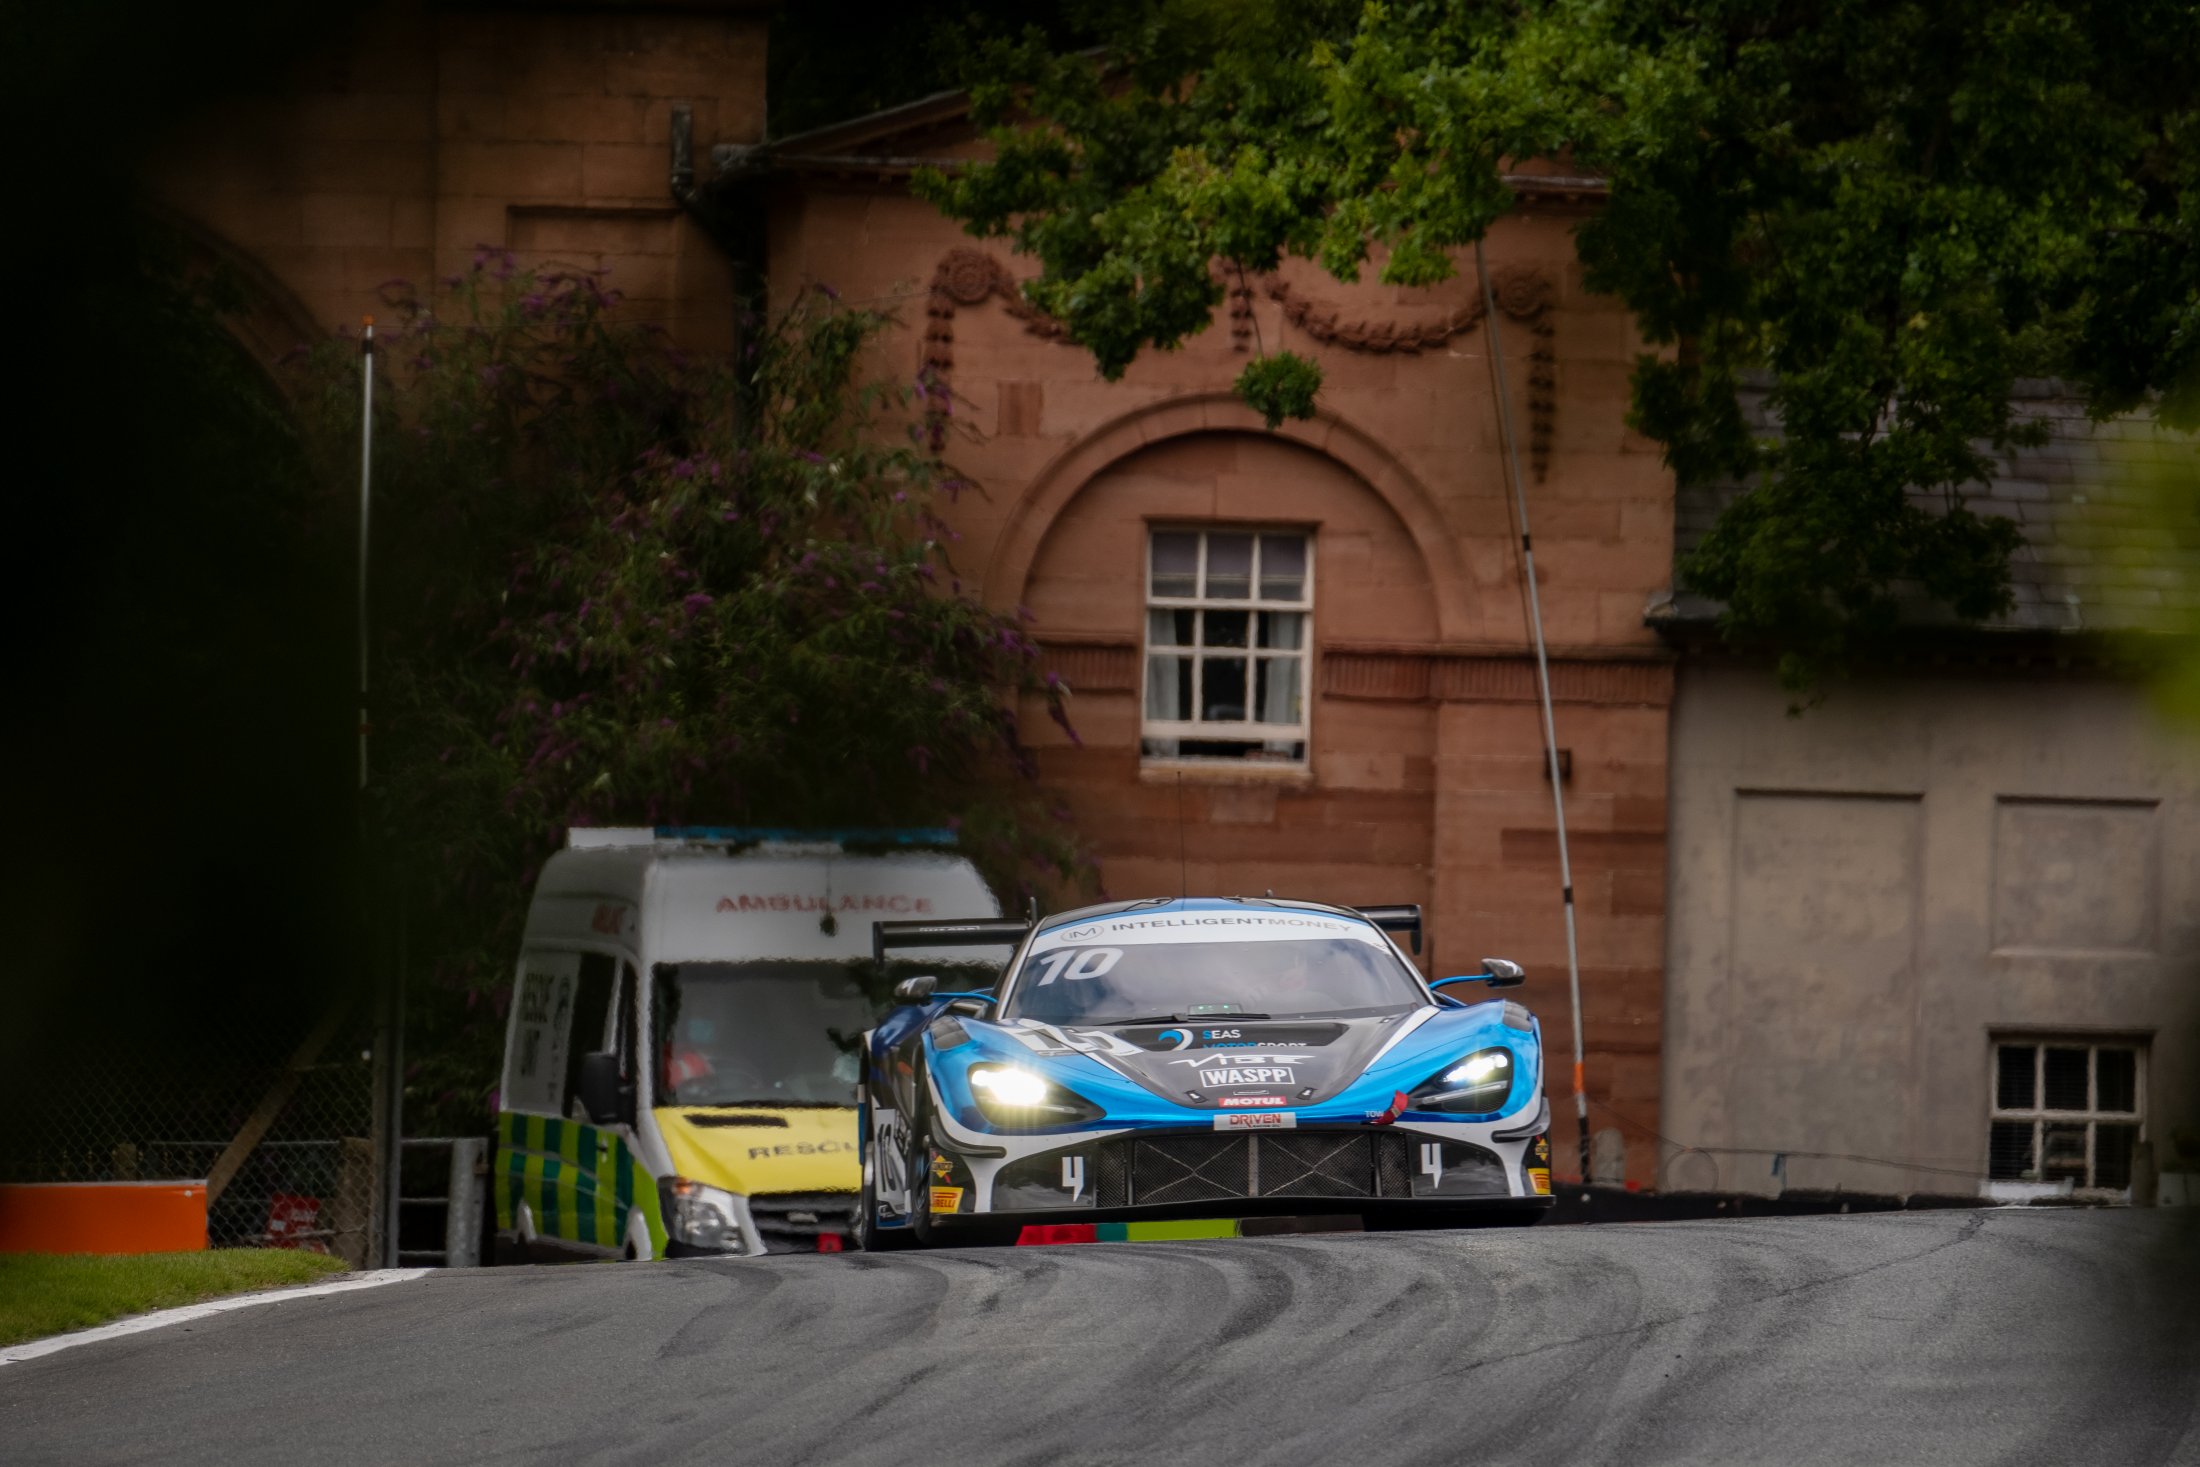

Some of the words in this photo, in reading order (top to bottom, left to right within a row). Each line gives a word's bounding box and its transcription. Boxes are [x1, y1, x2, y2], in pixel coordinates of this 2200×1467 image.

[716, 894, 934, 914] AMBULANCE
[1037, 947, 1124, 987] 10
[1202, 1029, 1242, 1039] SEAS
[1206, 1068, 1287, 1085] WASPP
[1223, 1097, 1284, 1106] MOTUL
[1229, 1113, 1281, 1127] DRIVEN
[1421, 1143, 1443, 1189] 4
[1062, 1157, 1085, 1202] 4
